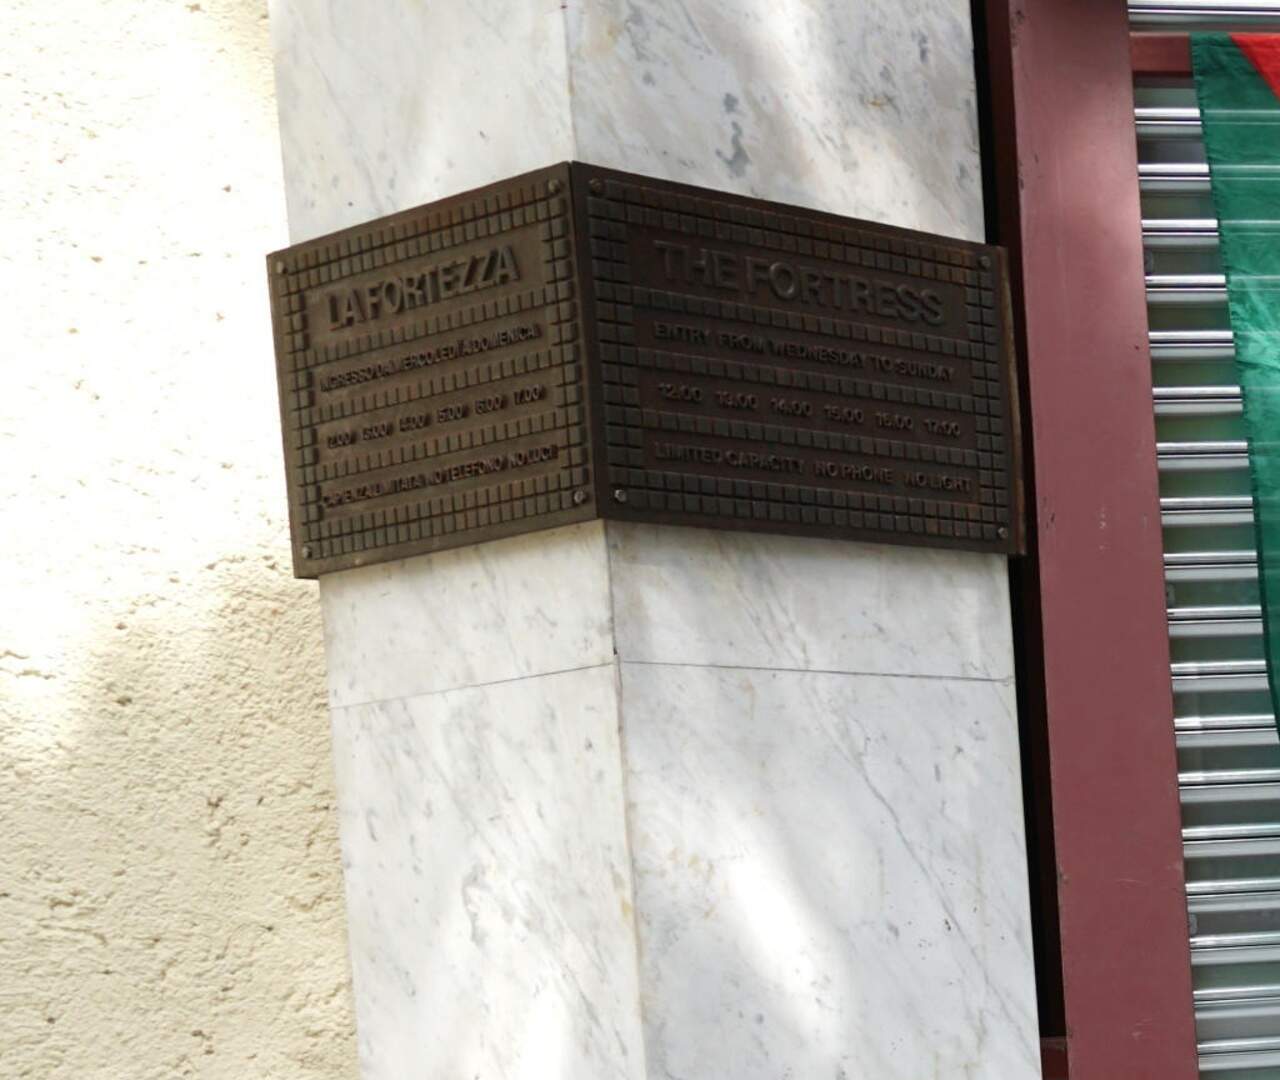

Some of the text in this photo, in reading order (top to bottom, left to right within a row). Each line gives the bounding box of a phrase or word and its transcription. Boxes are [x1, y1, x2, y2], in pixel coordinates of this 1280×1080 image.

[326, 244, 520, 331] LA FORTEZZA
[653, 240, 945, 325] THE FORTRESS
[653, 320, 955, 381] ENTRY FROM WEDNESDAY TO SUNDAY
